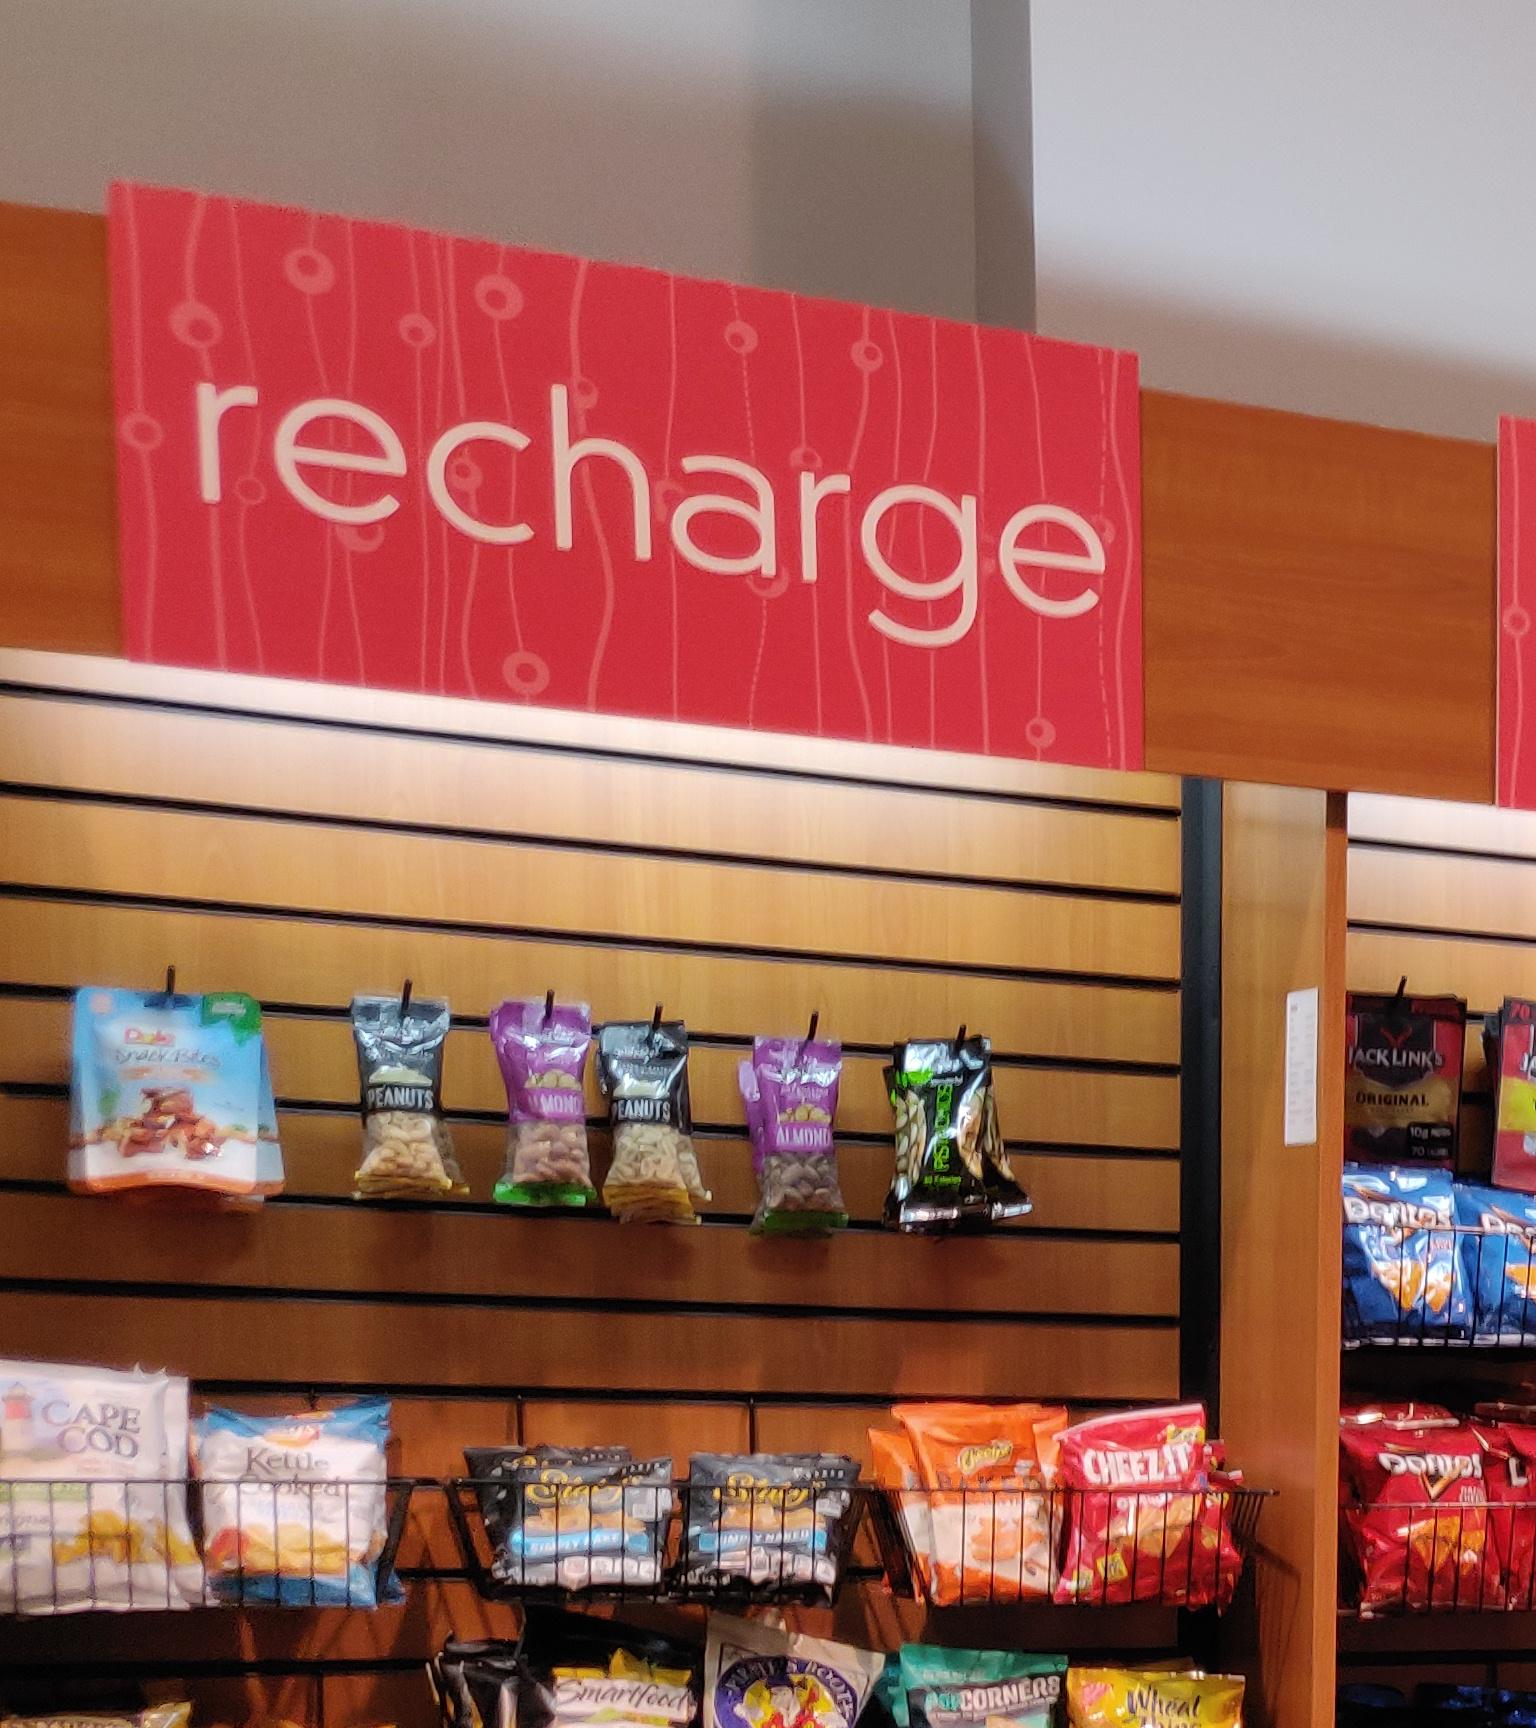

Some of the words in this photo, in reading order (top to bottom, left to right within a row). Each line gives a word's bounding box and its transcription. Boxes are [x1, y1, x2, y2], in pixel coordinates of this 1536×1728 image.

[197, 382, 1107, 647] recharge
[1349, 1046, 1390, 1067] JACK
[367, 1086, 435, 1112] PEANUTS
[1354, 1091, 1430, 1108] ORIGINAL
[41, 1400, 142, 1434] CAPE
[57, 1424, 140, 1459] COD
[245, 1446, 331, 1474] Kettle
[557, 1678, 690, 1711] Smartfood
